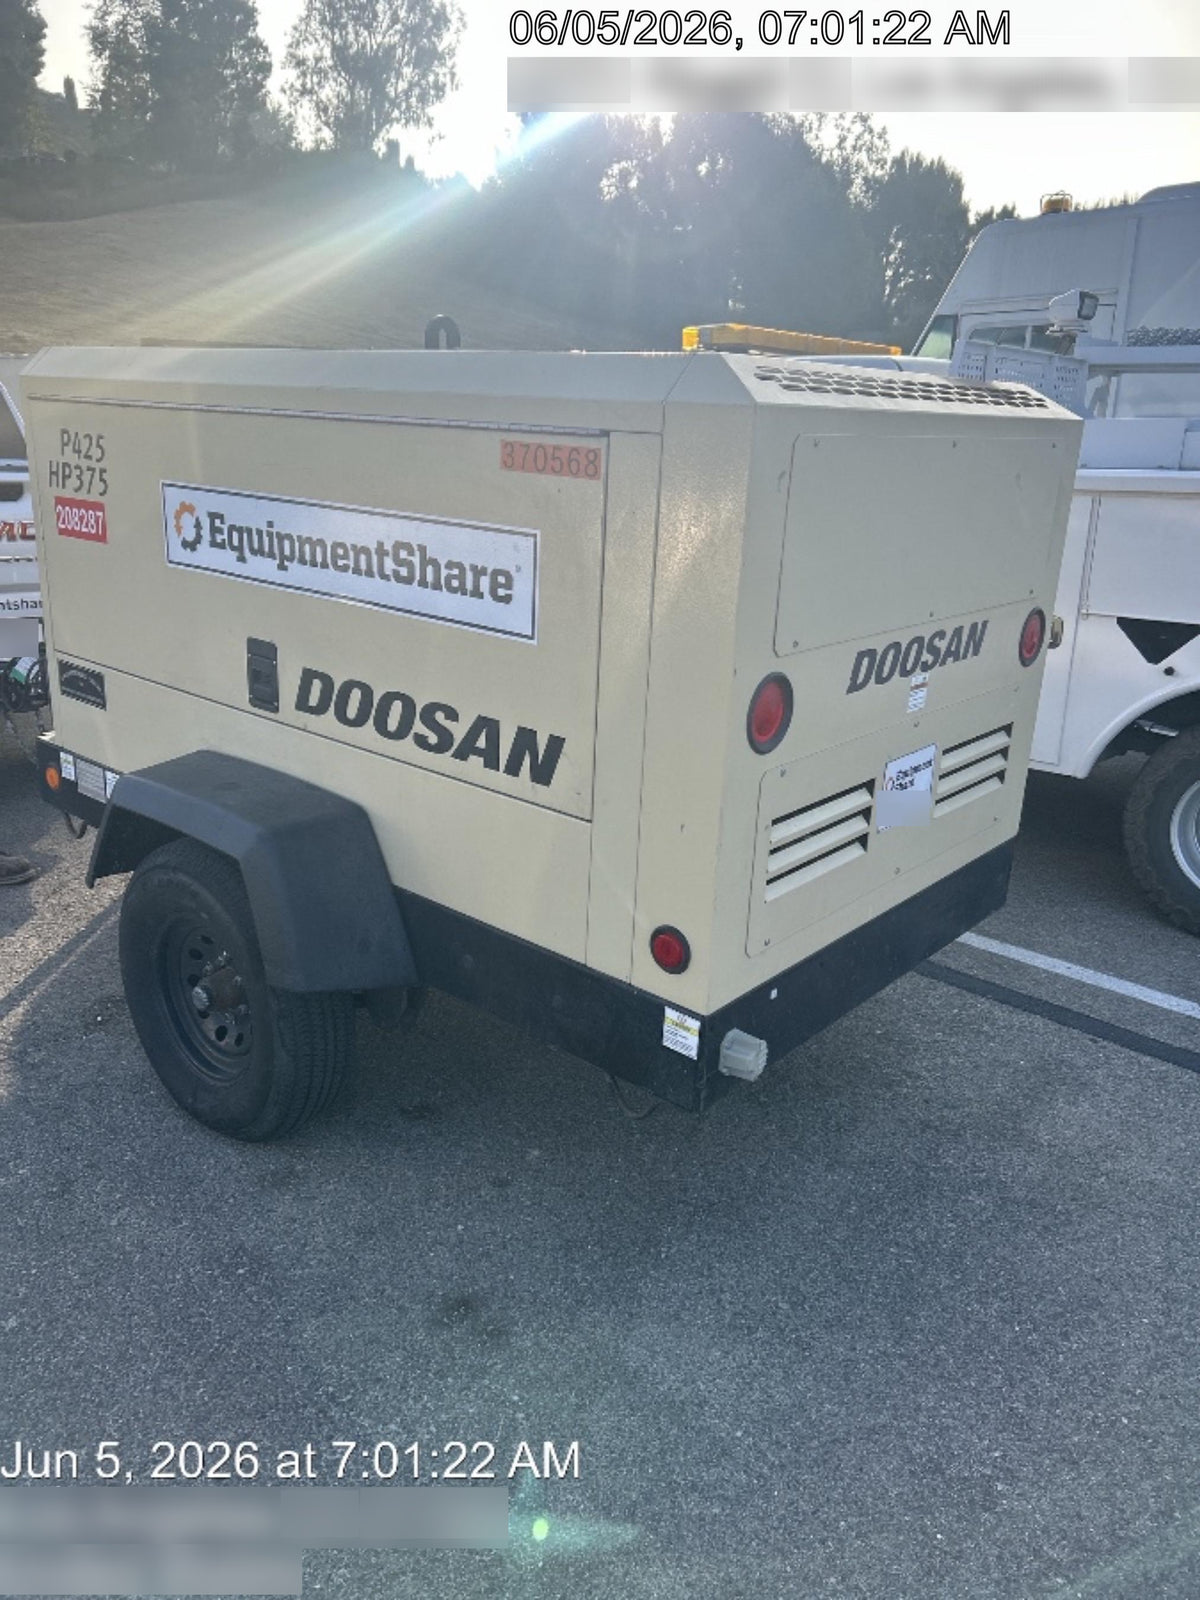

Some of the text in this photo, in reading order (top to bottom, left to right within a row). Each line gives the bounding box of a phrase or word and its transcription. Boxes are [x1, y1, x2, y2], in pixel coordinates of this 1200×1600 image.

[60, 428, 105, 463] P425
[502, 441, 598, 477] 370568
[49, 460, 108, 496] HP375
[56, 505, 104, 535] 208287
[206, 510, 514, 605] EquipmentShare
[847, 620, 989, 695] DOOSAN
[294, 667, 566, 787] DOOSAN
